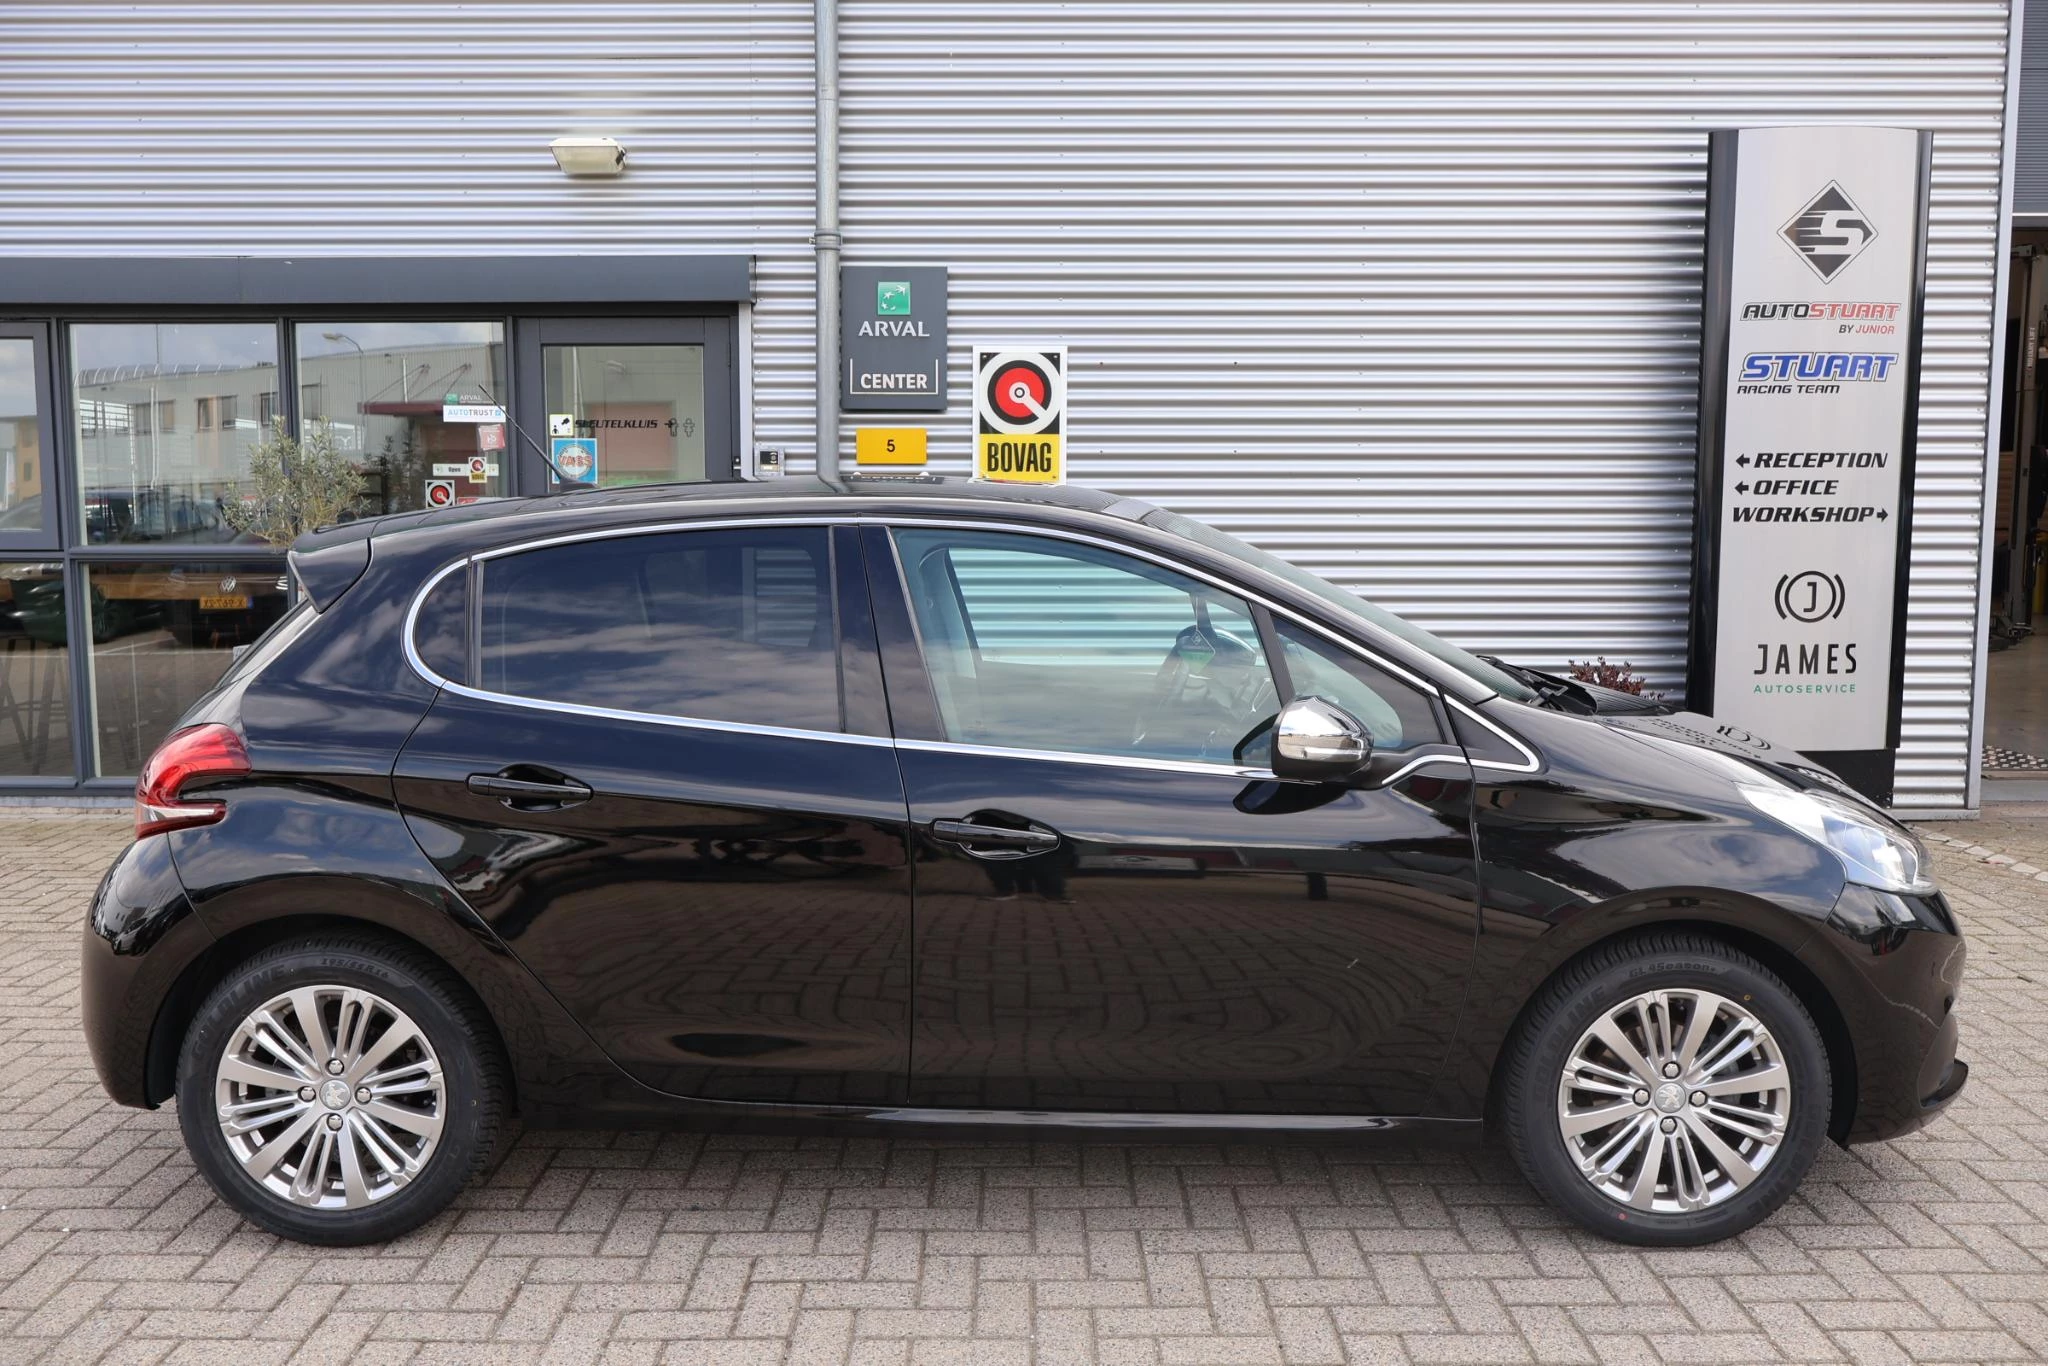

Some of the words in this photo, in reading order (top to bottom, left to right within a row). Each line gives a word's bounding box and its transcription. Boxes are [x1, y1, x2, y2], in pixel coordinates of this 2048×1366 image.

[1741, 302, 1900, 321] AUTOSTUART
[858, 321, 930, 337] ARVAL
[1838, 325, 1854, 334] BY
[1855, 325, 1895, 335] JUNIOR
[1739, 353, 1898, 381] STUART
[860, 373, 928, 389] CENTER
[1737, 385, 1792, 394] RACING
[1797, 385, 1840, 394] TEAM
[447, 409, 494, 417] AUTOTRUST
[575, 419, 658, 429] SLEUTELKLUIS
[886, 439, 896, 453] 5
[987, 442, 1052, 473] BOVAG
[1754, 452, 1888, 468] RECEPTION
[1753, 480, 1839, 495] OFFICE
[1733, 507, 1874, 522] WORKSHOP
[1754, 643, 1857, 675] JAMES
[1753, 684, 1856, 694] AUTOSERVICE
